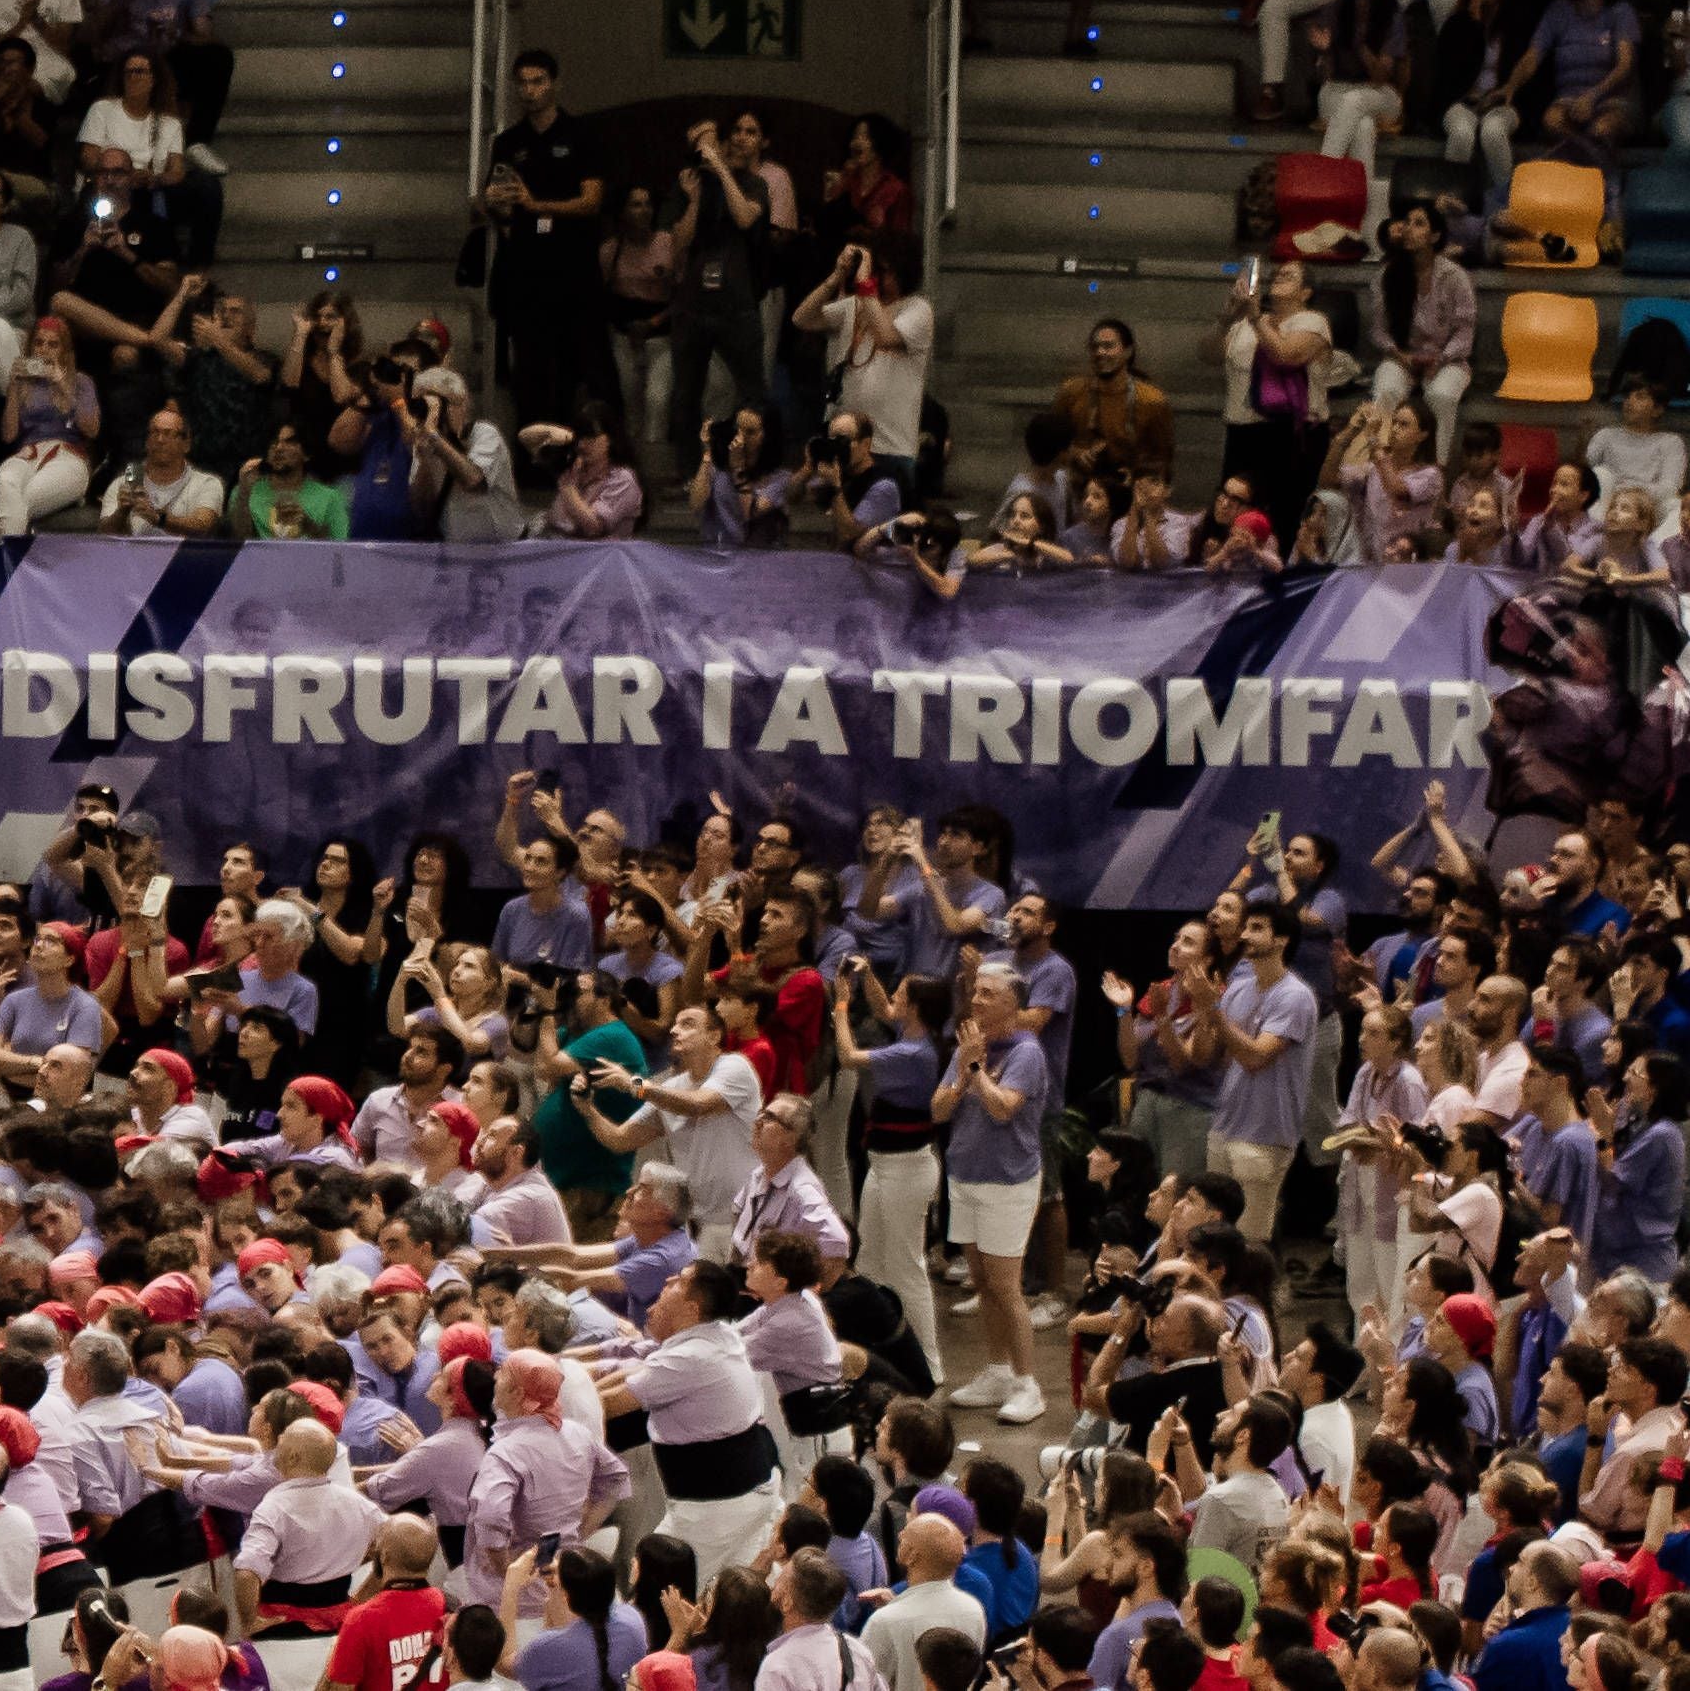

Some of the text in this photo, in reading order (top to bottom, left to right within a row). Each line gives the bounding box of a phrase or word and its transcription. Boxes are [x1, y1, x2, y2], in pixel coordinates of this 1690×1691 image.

[1, 649, 664, 746] DISFRUTAR
[701, 662, 734, 750] I
[755, 666, 850, 757] A
[871, 669, 1494, 770] TRIOMFAR
